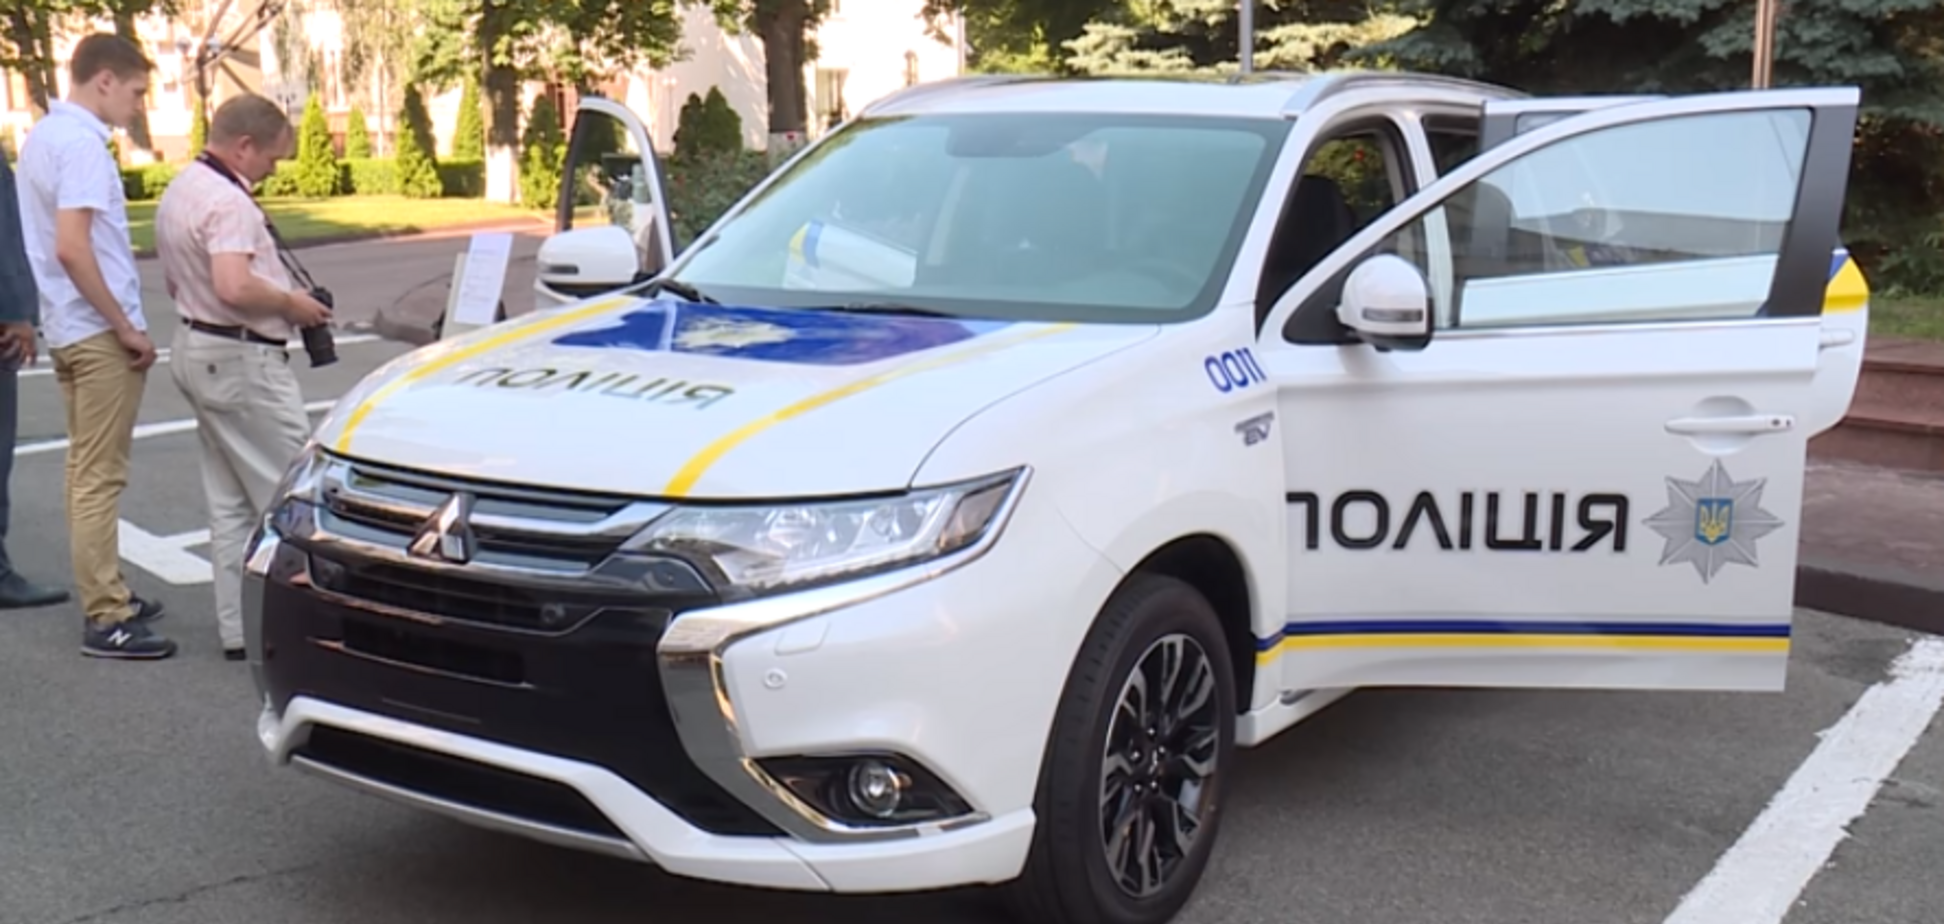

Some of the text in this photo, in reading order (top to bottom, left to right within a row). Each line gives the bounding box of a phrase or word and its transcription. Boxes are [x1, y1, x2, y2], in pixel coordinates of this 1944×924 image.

[451, 367, 736, 410] ПОЛІЦІЯ
[1204, 346, 1267, 393] 0011
[107, 628, 132, 646] N
